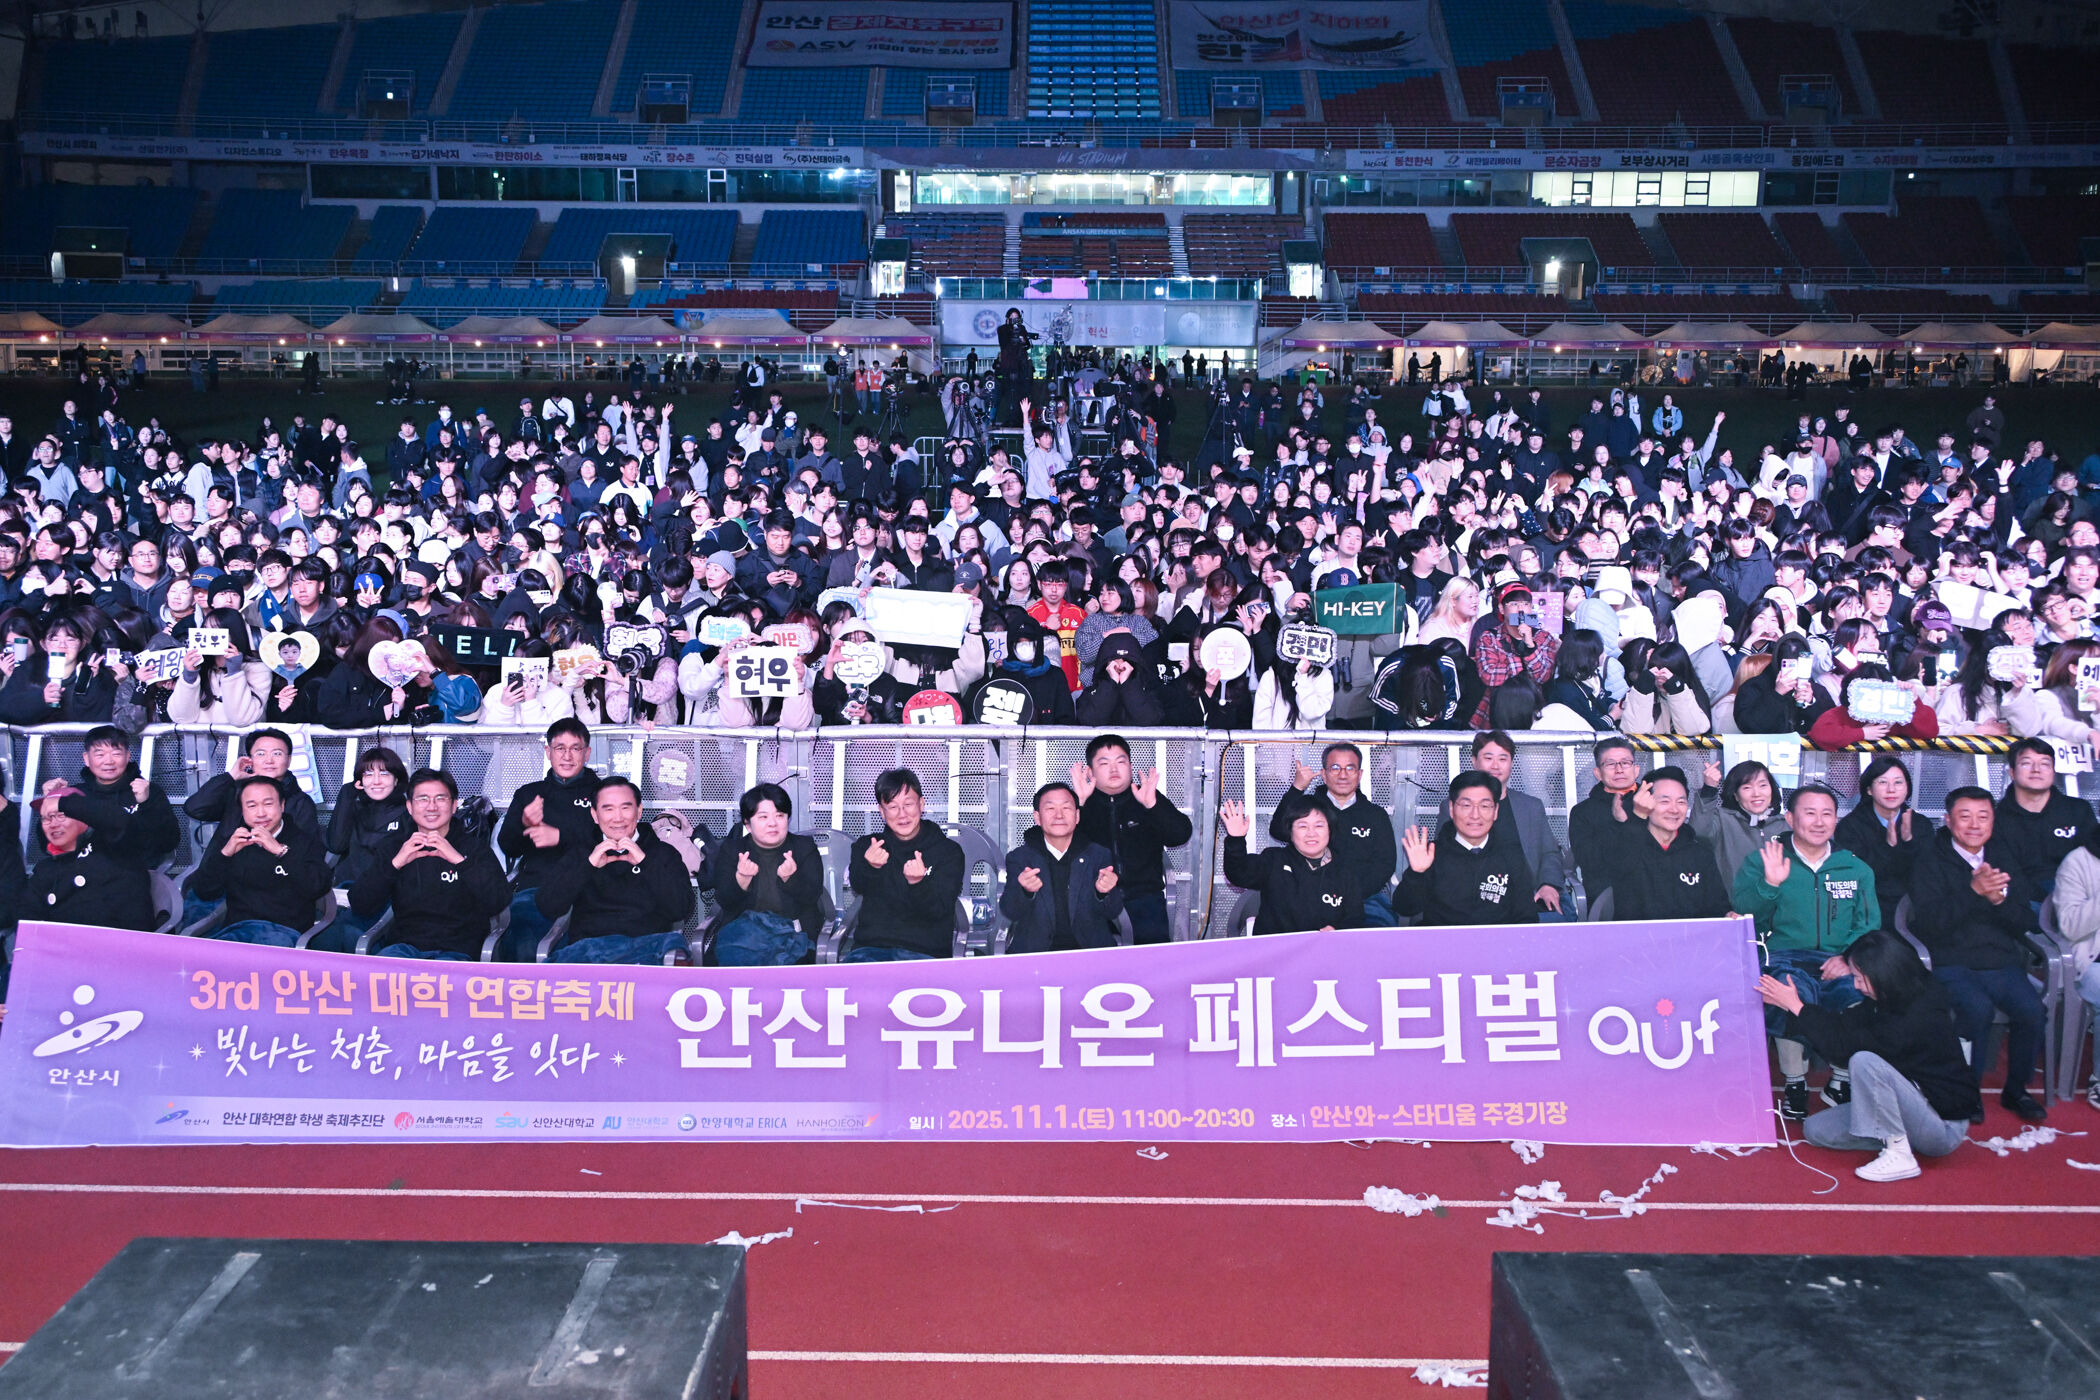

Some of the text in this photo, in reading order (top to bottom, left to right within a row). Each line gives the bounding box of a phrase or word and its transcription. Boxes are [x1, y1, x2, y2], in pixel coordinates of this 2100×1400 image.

[766, 16, 824, 30] 안산
[799, 40, 856, 53] ASV
[410, 149, 460, 160] 김가네낙지
[1056, 151, 1128, 166] WA STADIUM
[1620, 155, 1690, 168] 보부상사거리
[736, 655, 791, 696] 현우
[2057, 744, 2088, 765] 아민
[191, 969, 635, 1021] 3rd 안산 대학 연합축제
[665, 971, 1560, 1069] 안산 유니온 페스티벌
[217, 1024, 600, 1083] 빛나는 청춘, 마음을 잇다
[47, 1066, 120, 1087] 안산시
[223, 1111, 384, 1128] 안산 대학연합 학생 축제추진단
[416, 1116, 483, 1124] 서울예술대학교
[1271, 1114, 1298, 1128] 장소
[1484, 1101, 1568, 1127] 주경기장
[533, 1117, 595, 1129] 신안산대학교
[602, 1116, 622, 1130] AU
[701, 1117, 787, 1129] 한양대학교 ERICA
[910, 1116, 935, 1130] 일시
